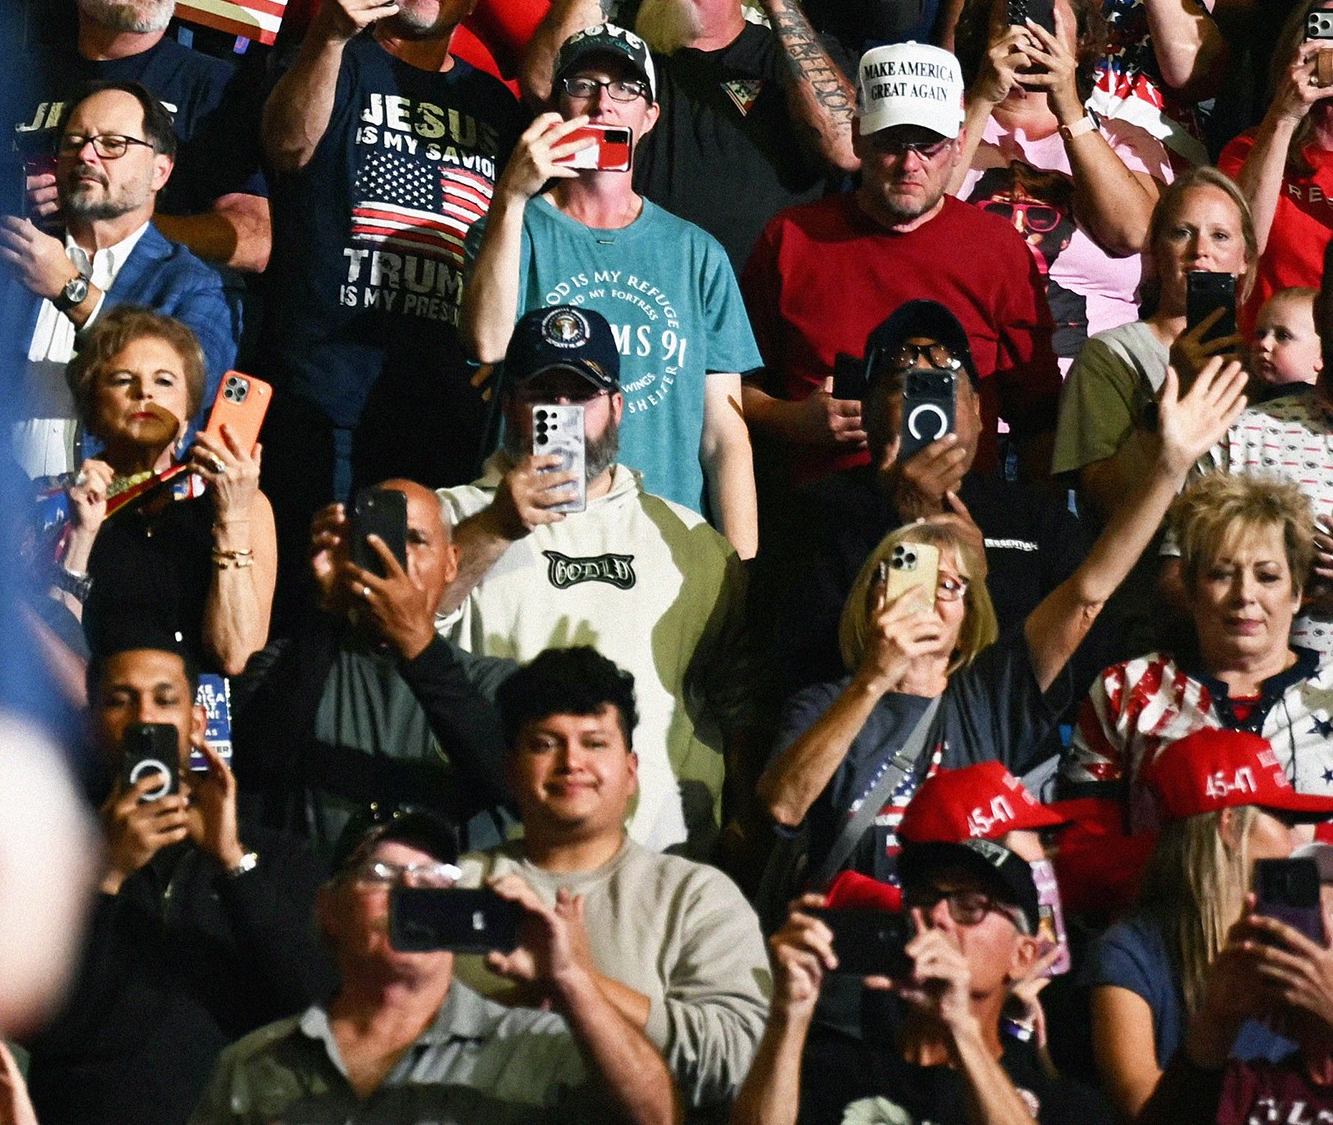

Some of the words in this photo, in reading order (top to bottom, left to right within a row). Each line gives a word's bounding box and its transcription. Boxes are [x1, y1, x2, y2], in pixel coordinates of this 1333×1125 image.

[864, 61, 896, 81] MAKE
[896, 61, 955, 82] AMERICA
[871, 82, 908, 101] GREAT
[910, 83, 949, 102] AGAIN
[355, 126, 378, 145] IS
[383, 131, 419, 155] MY
[425, 142, 496, 177] SAVIO
[343, 247, 464, 306] TRUM
[339, 284, 358, 307] IS
[364, 286, 397, 312] MY
[568, 294, 585, 307] ND
[589, 289, 605, 300] MY
[611, 289, 659, 322] FORTRESS
[571, 273, 589, 288] IS
[594, 270, 622, 283] MY
[626, 275, 680, 330] REFUGE
[661, 329, 687, 369] 91
[621, 371, 656, 394] WINGS
[1206, 765, 1258, 800] 45-47
[966, 794, 1015, 837] 45-47
